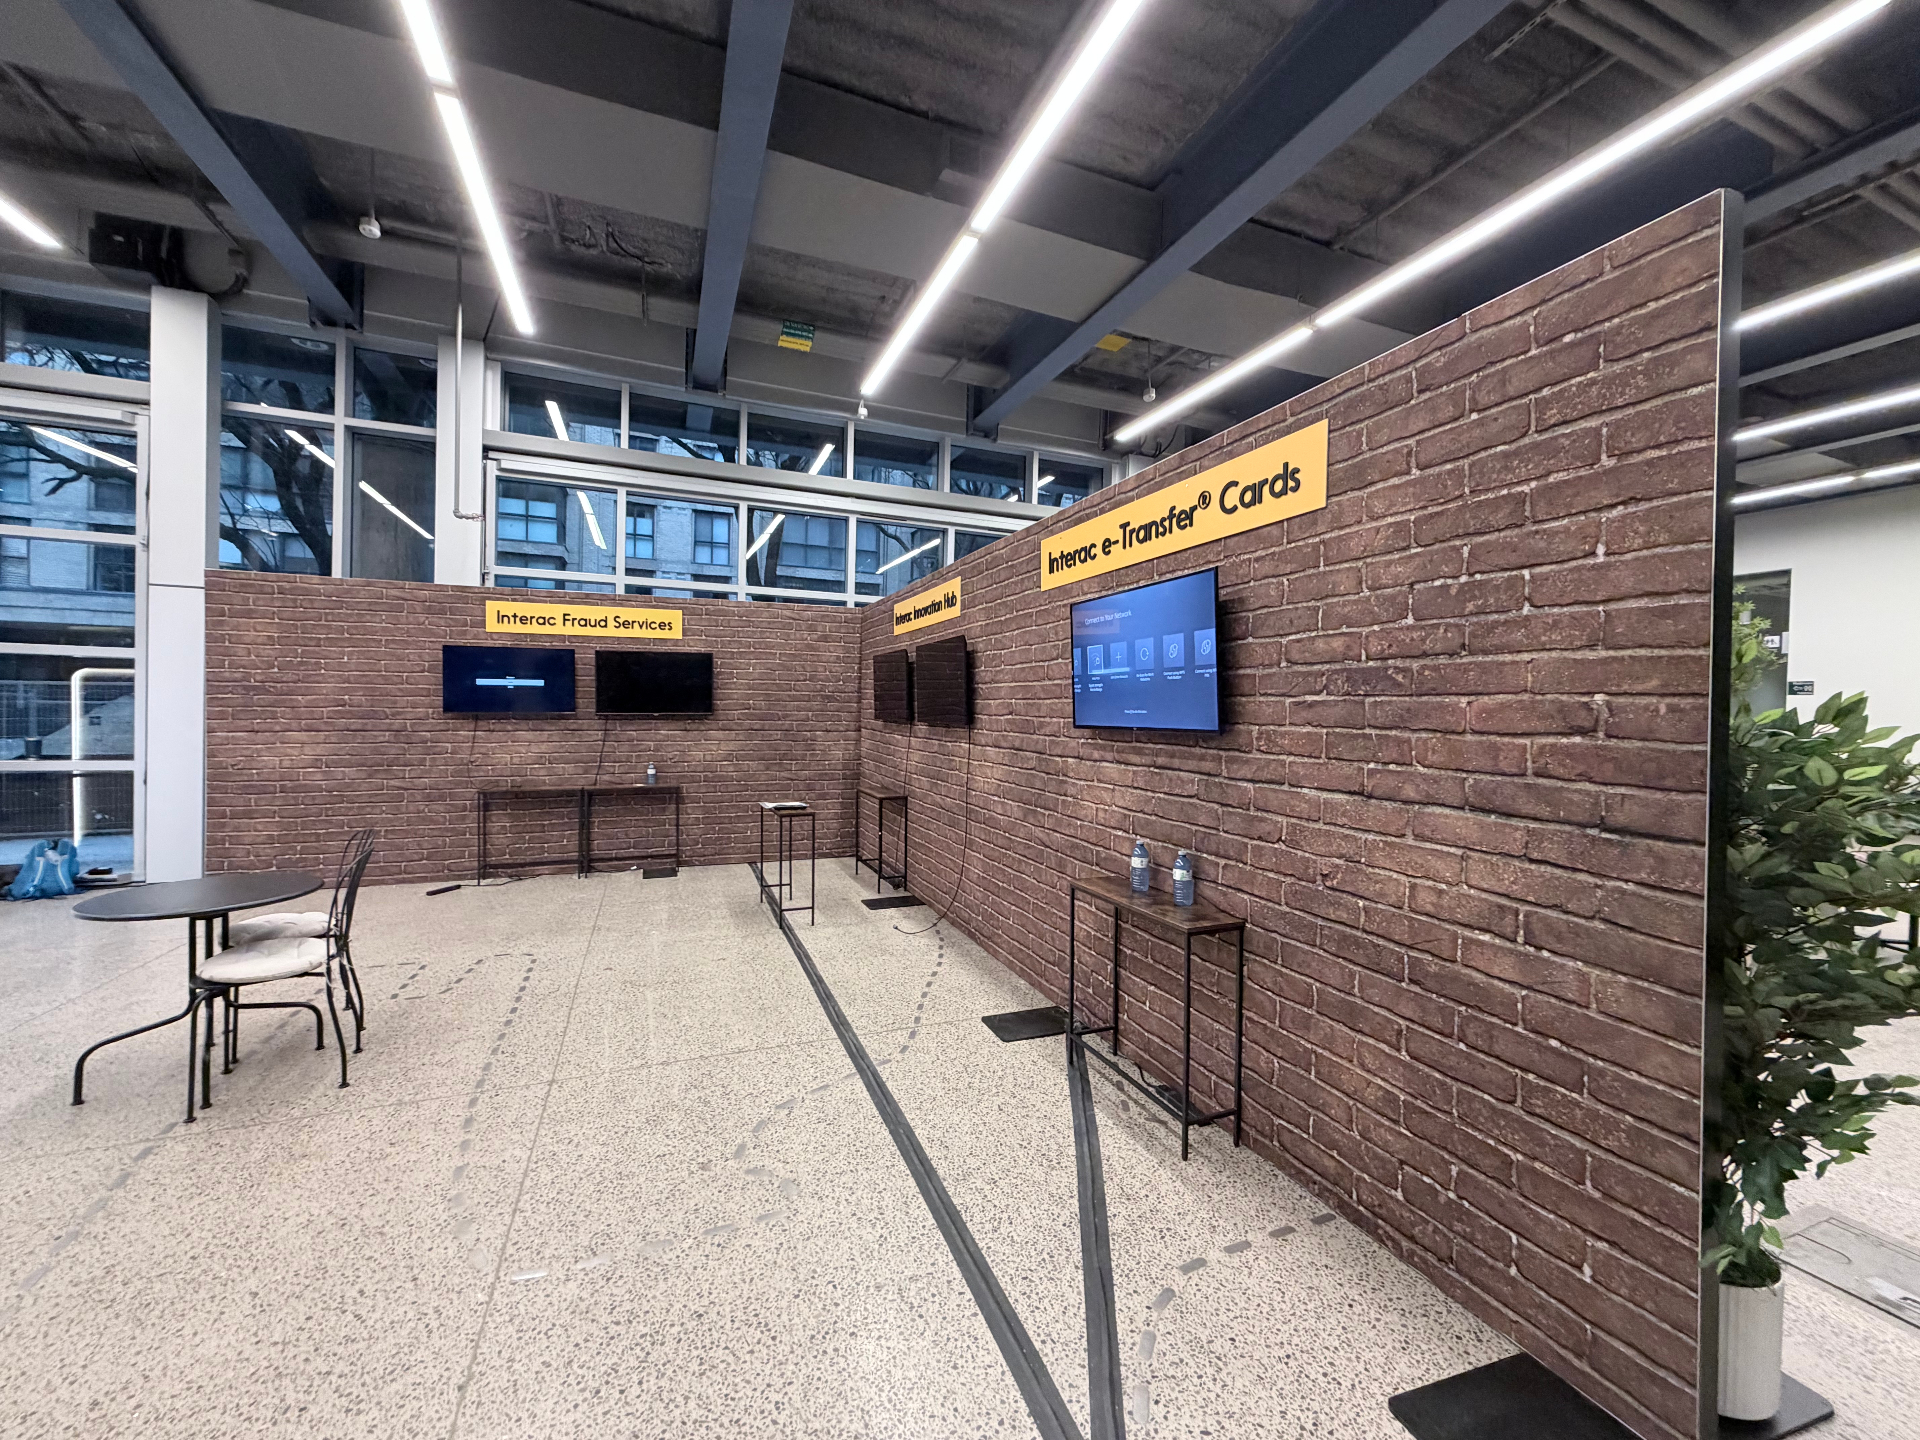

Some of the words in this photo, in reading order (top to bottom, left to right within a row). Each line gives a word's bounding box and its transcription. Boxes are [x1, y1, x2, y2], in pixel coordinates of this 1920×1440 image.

[1048, 541, 1097, 574] Interac
[1219, 462, 1301, 514] Cards
[496, 610, 557, 627] Interac
[562, 613, 609, 629] Fraud
[613, 615, 674, 631] Services
[895, 612, 912, 626] Interac
[913, 599, 943, 620] Innovation
[943, 591, 958, 610] Hub
[1084, 616, 1100, 625] Connect
[1114, 610, 1132, 619] Network
